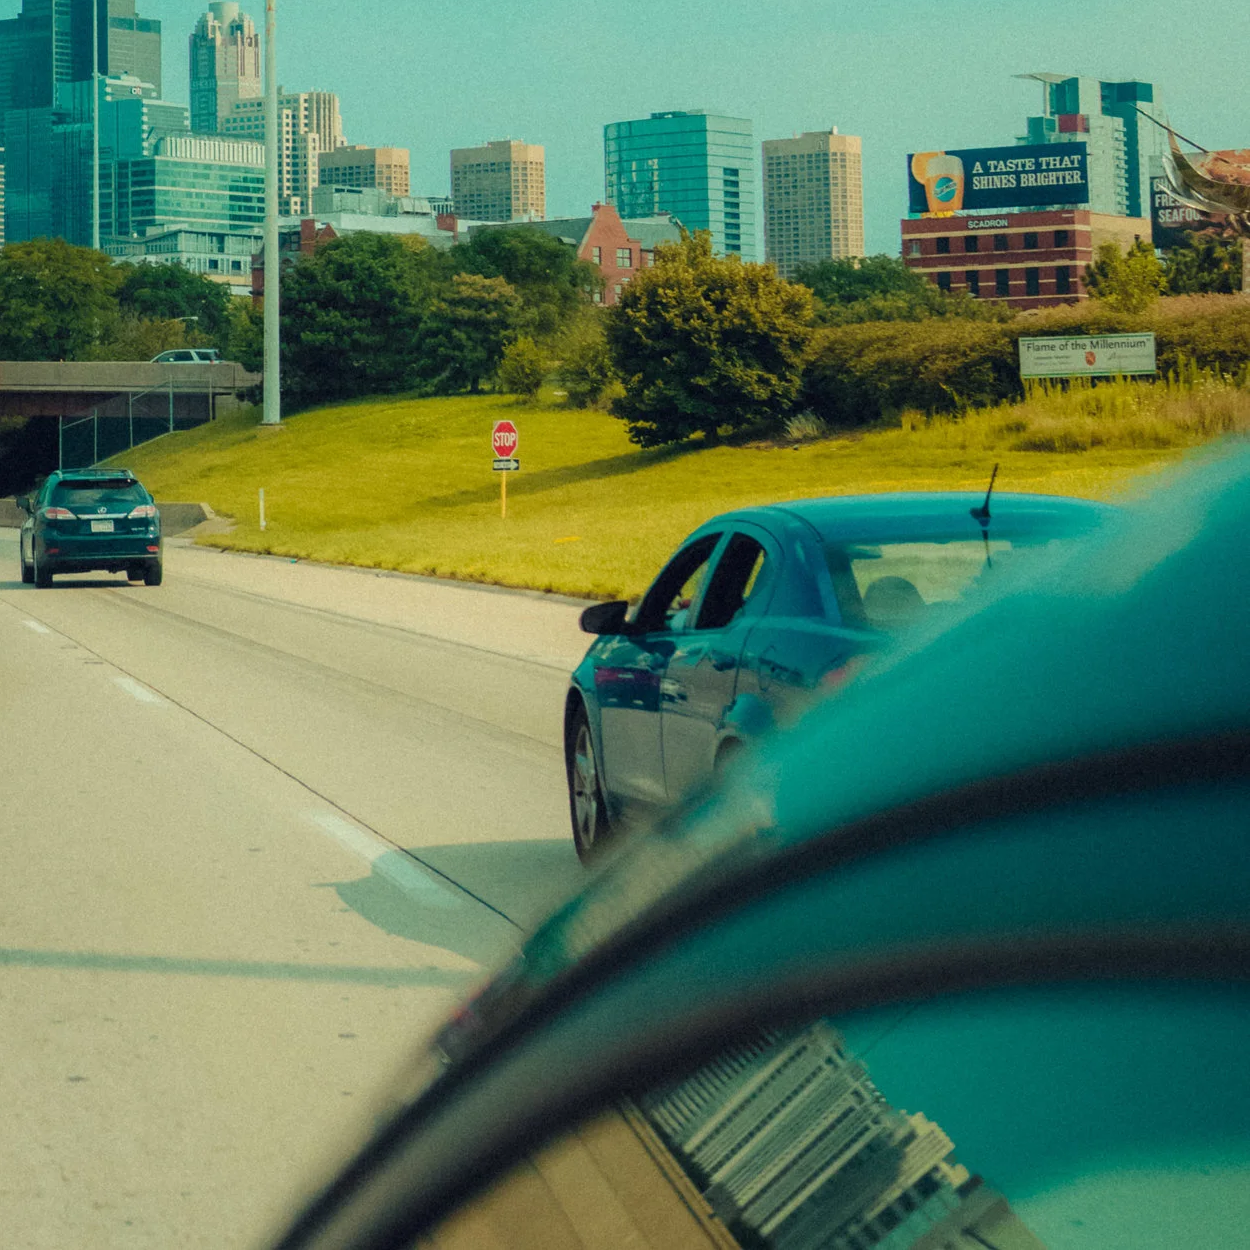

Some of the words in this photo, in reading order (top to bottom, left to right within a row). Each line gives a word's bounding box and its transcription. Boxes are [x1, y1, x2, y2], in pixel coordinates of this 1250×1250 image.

[972, 161, 983, 174] A
[987, 158, 1036, 173] TASTE
[1039, 155, 1082, 169] THAT
[972, 174, 1017, 190] SHINES
[1020, 170, 1086, 188] BRIGHTER.
[967, 219, 1009, 229] SCADRON
[1059, 341, 1069, 351] of
[1071, 340, 1087, 350] the
[494, 432, 516, 447] STOP
